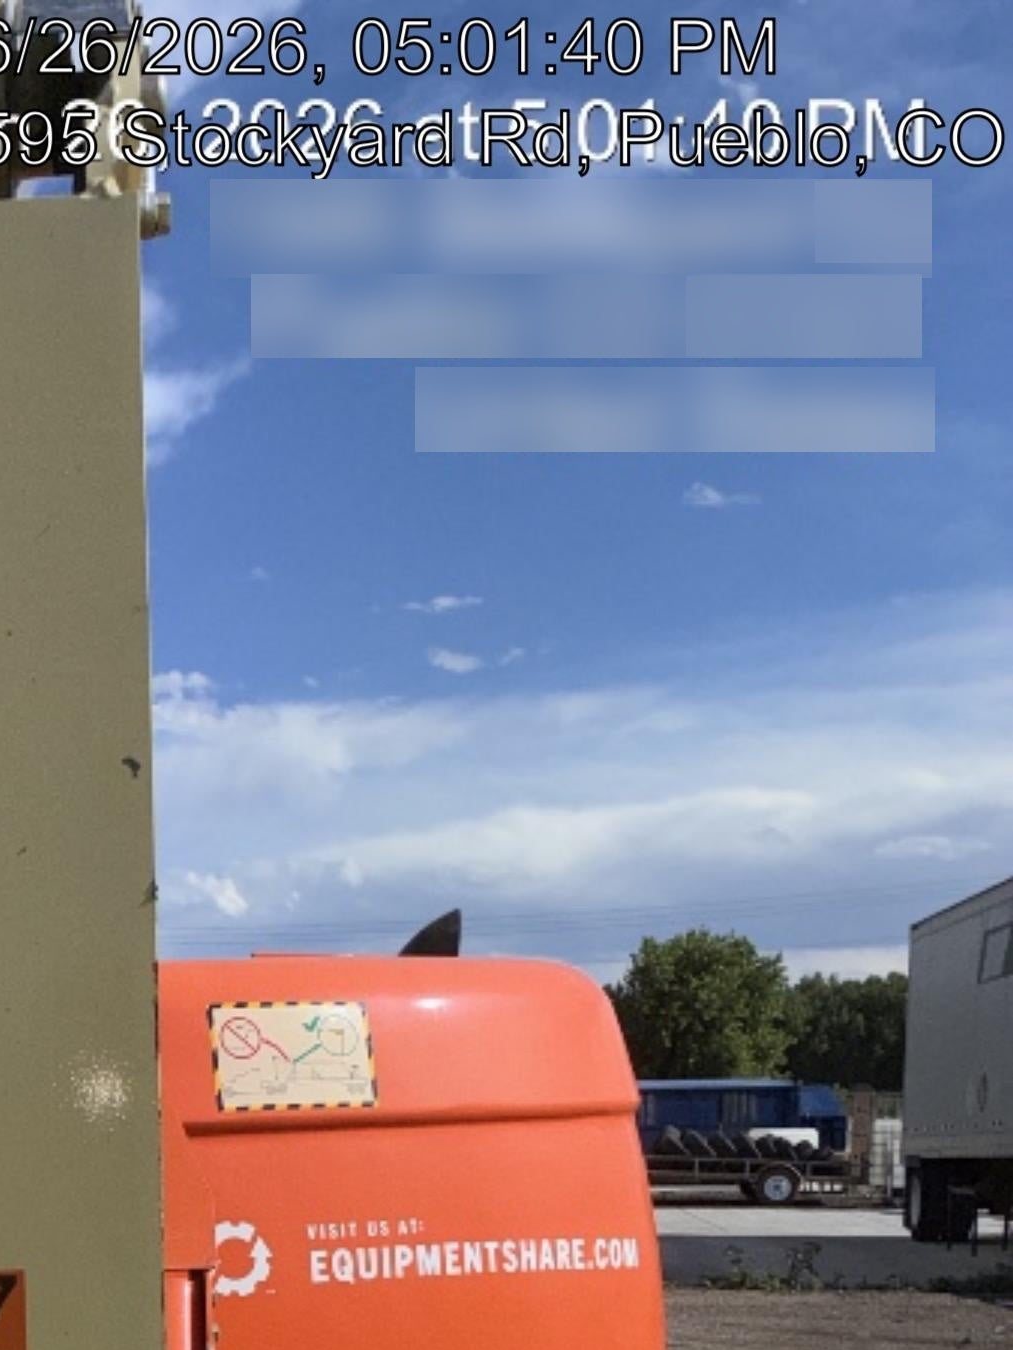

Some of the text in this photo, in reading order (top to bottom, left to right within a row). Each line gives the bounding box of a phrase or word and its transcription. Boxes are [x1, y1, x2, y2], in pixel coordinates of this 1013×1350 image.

[306, 1218, 425, 1240] VISIT US AT:
[310, 1238, 640, 1285] EQUIPMENTSHARE.COM
